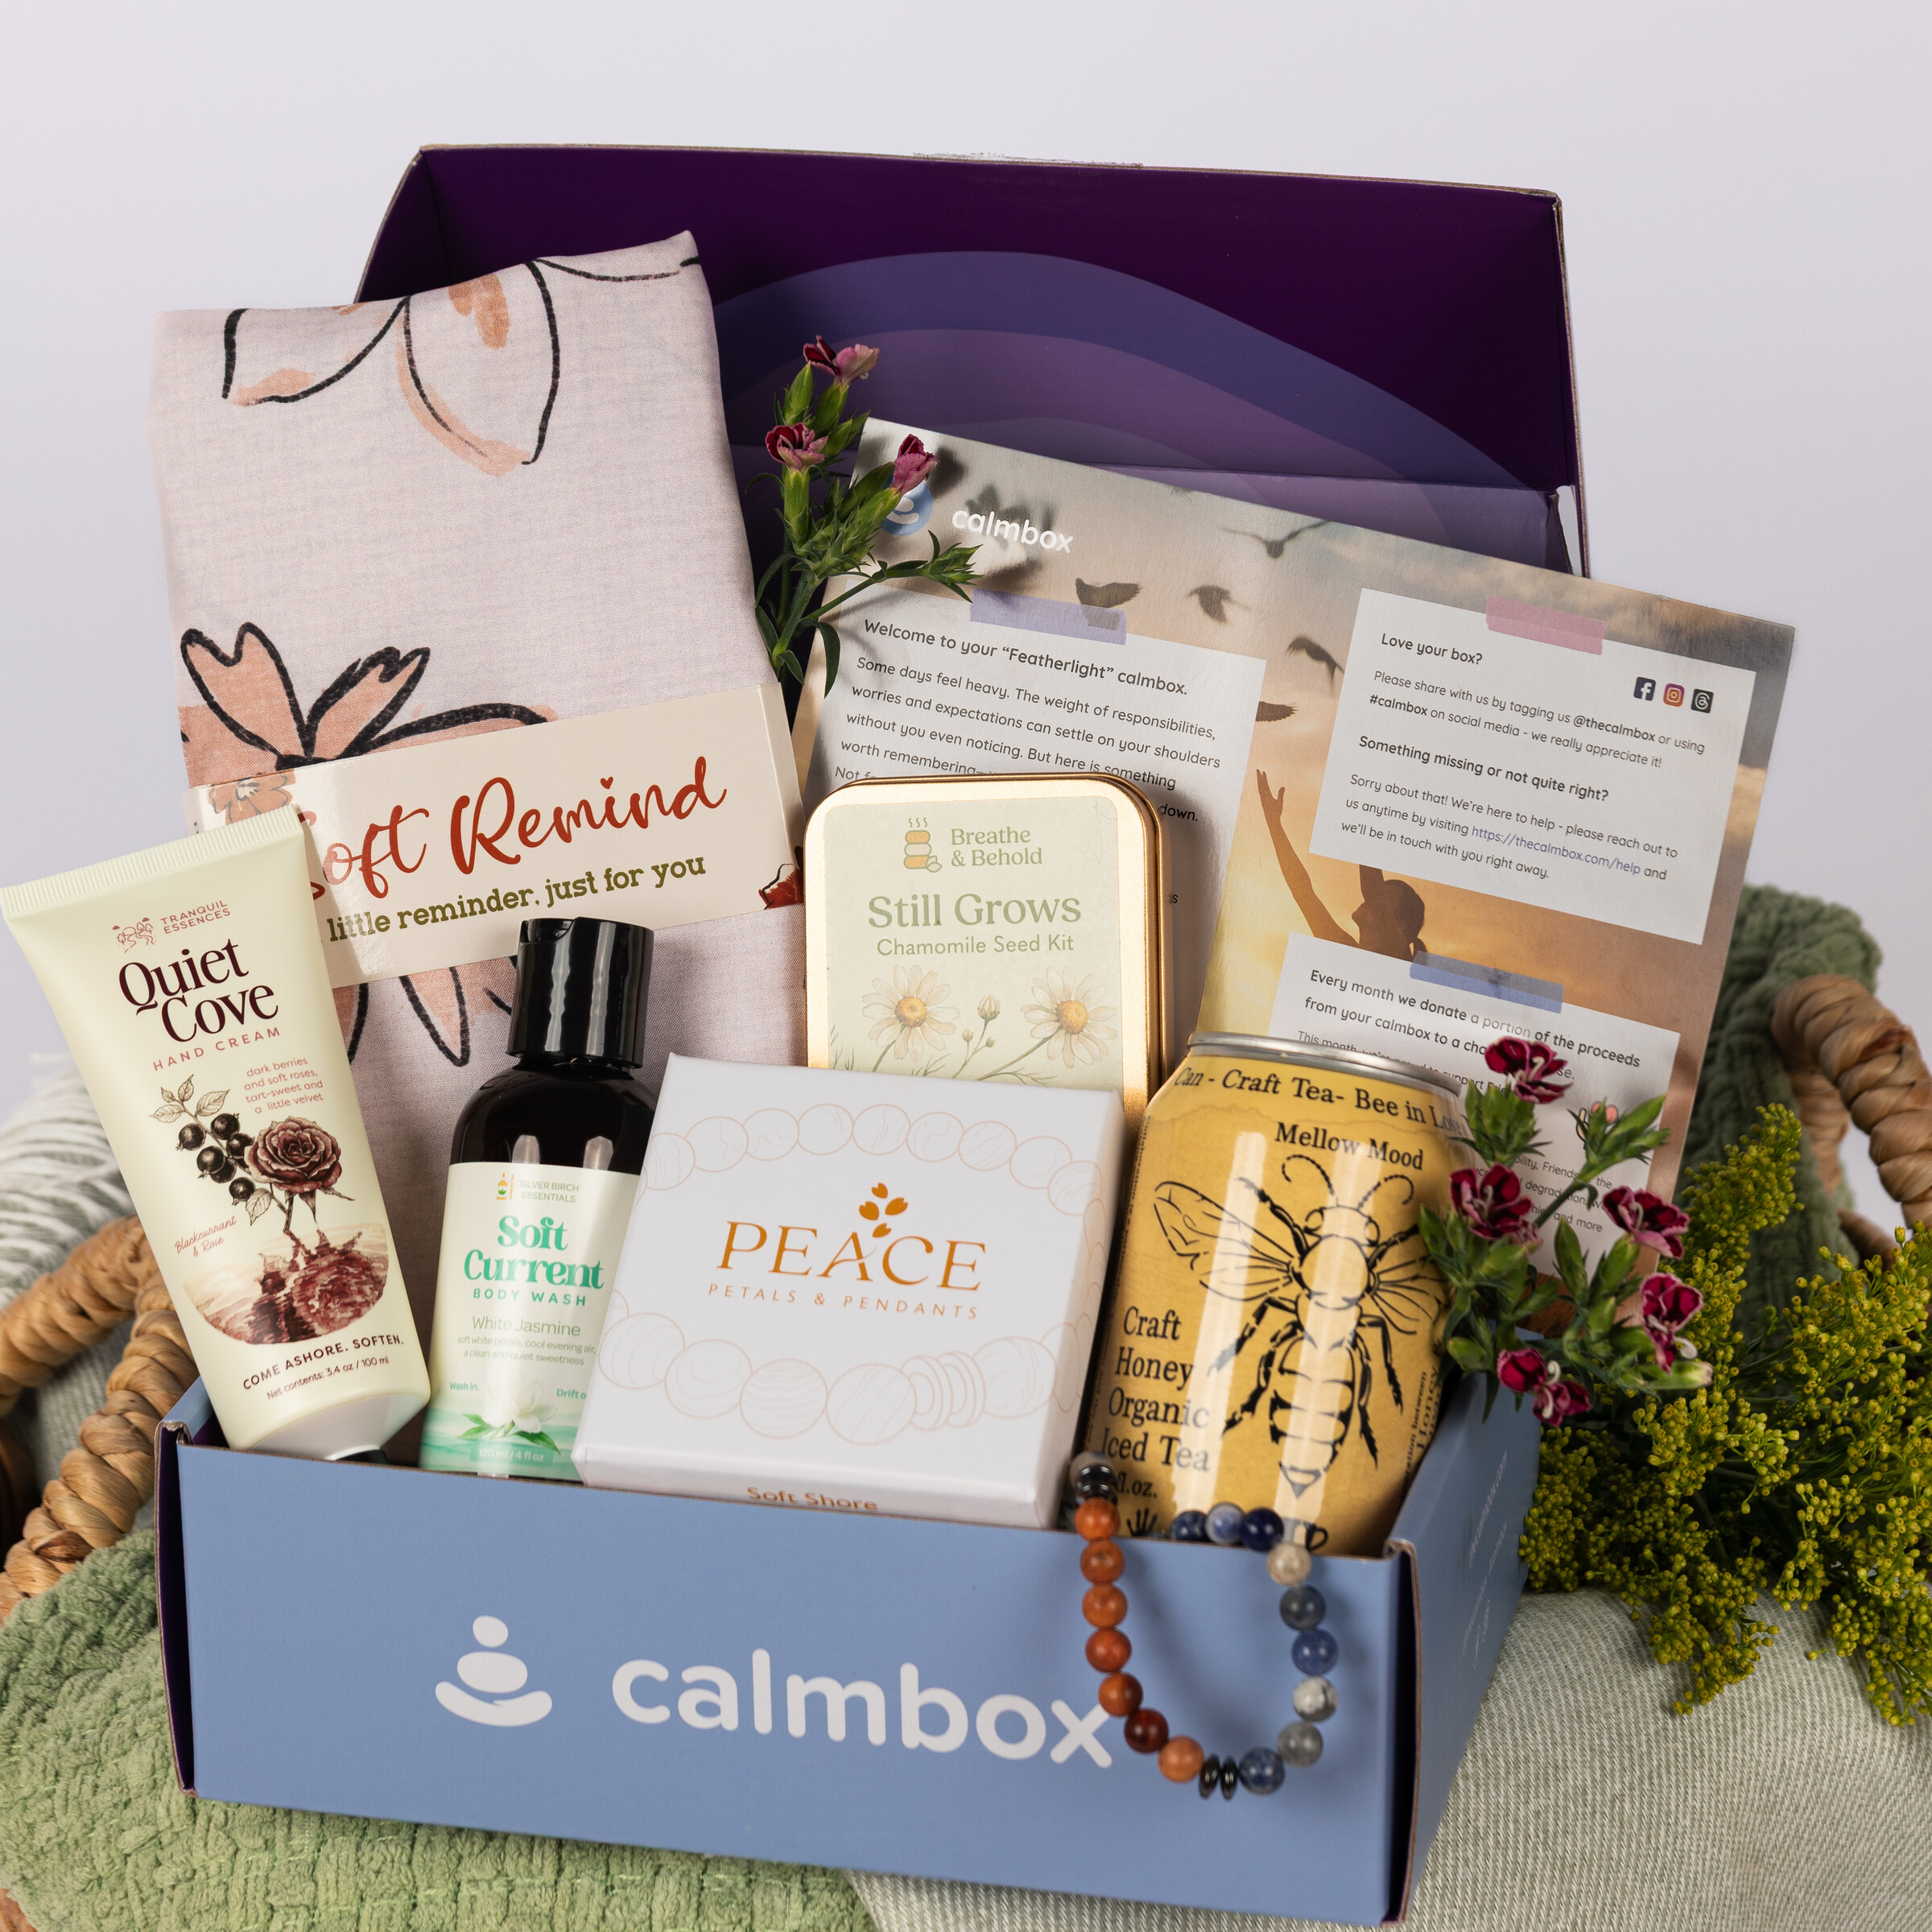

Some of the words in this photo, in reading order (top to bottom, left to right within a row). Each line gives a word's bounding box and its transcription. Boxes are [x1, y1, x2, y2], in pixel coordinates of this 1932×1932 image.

[952, 508, 1073, 553] calmbox
[865, 619, 935, 645] Welcome
[940, 635, 956, 649] to
[960, 641, 997, 656] your
[1117, 672, 1187, 695] calmbox.
[1381, 633, 1413, 650] Love
[1416, 642, 1447, 657] your
[1451, 647, 1482, 664] box?
[857, 656, 895, 675] Some
[899, 665, 931, 683] days
[936, 672, 962, 687] feel
[965, 678, 1009, 699] heavy.
[1015, 687, 1039, 703] The
[1044, 696, 1089, 713] weight
[1093, 705, 1109, 716] of
[1112, 710, 1215, 740] responsibilities,
[1374, 671, 1411, 687] Please
[1414, 679, 1446, 696] share
[1450, 688, 1472, 701] with
[1476, 695, 1488, 704] us
[1492, 696, 1506, 711] by
[1509, 700, 1554, 721] tagging
[1557, 713, 1571, 723] us
[1573, 715, 1655, 741] @thecalmbox
[1657, 735, 1671, 744] or
[1674, 739, 1704, 754] using
[852, 683, 901, 704] worries
[905, 697, 931, 710] and
[935, 703, 1022, 728] expectations
[1026, 721, 1051, 734] can
[1055, 727, 1093, 742] settle
[1097, 736, 1114, 746] on
[1118, 740, 1150, 753] your
[1154, 745, 1220, 767] shoulders
[1369, 694, 1427, 716] #calmbox
[1430, 709, 1444, 719] on
[1447, 713, 1481, 727] social
[1484, 721, 1519, 736] media
[1531, 731, 1547, 742] we
[1550, 736, 1582, 752] really
[1585, 744, 1648, 764] appreciate
[1650, 756, 1662, 767] it!
[1359, 735, 1430, 764] Something
[1434, 754, 1483, 775] missing
[1487, 766, 1502, 777] or
[1505, 770, 1528, 783] not
[1531, 776, 1565, 791] quite
[1568, 783, 1608, 801] right?
[450, 755, 727, 873] Remind
[1350, 774, 1381, 792] Sorry
[1385, 782, 1418, 799] about
[1422, 791, 1447, 805] that!
[1486, 804, 1512, 819] here
[1515, 811, 1527, 823] to
[1530, 814, 1554, 831] help
[1565, 824, 1604, 840] please
[1607, 835, 1639, 848] reach
[1642, 843, 1662, 854] out
[1666, 846, 1677, 857] to
[950, 826, 1031, 845] Breathe
[1346, 799, 1359, 809] us
[1361, 803, 1408, 819] anytime
[1411, 811, 1426, 826] by
[1429, 817, 1468, 836] visiting
[1472, 825, 1641, 875] https://thecalmbox.com/help
[1644, 868, 1667, 880] and
[952, 850, 965, 867] &
[972, 848, 1043, 866] Behold
[160, 900, 228, 924] TRANQUIL
[326, 911, 390, 943] little
[396, 888, 539, 929] reminder,
[544, 871, 597, 908] just
[603, 867, 644, 891] for
[650, 857, 706, 888] you
[868, 894, 942, 929] Still
[955, 893, 1082, 927] Grows
[163, 908, 230, 934] ESSENCES
[877, 935, 987, 956] Chamomile
[993, 934, 1040, 953] Seed
[1048, 933, 1075, 952] Kit
[118, 938, 250, 1016] Quiet
[161, 985, 279, 1044] Cove
[1305, 997, 1337, 1015] from
[1340, 1009, 1372, 1023] your
[1375, 1018, 1430, 1040] calmbox
[1311, 969, 1348, 991] Every
[1351, 982, 1393, 1001] month
[1398, 994, 1416, 1007] we
[1420, 999, 1467, 1021] donate
[1534, 1030, 1550, 1042] of
[1553, 1034, 1575, 1050] the
[1578, 1042, 1641, 1068] proceeds
[152, 1047, 204, 1071] HAND
[215, 1027, 279, 1051] CREAM
[246, 1064, 271, 1076] dark
[272, 1057, 308, 1070] berries
[244, 1077, 265, 1090] and
[267, 1072, 287, 1084] soft
[289, 1069, 318, 1079] roses,
[245, 1084, 302, 1103] tart-sweet
[303, 1079, 323, 1089] and
[1221, 1068, 1282, 1094] Craft
[1355, 1088, 1398, 1117] Bee
[1405, 1100, 1426, 1124] in
[266, 1098, 291, 1110] little
[292, 1092, 323, 1104] velvet
[1274, 1121, 1360, 1154] Mellow
[1367, 1137, 1423, 1170] Mood
[520, 1180, 549, 1190] SILVER
[551, 1182, 579, 1191] BIRCH
[522, 1191, 576, 1203] ESSENTIALS
[174, 1216, 237, 1254] Blackcurrant
[192, 1246, 198, 1257] &
[201, 1236, 225, 1253] Rose
[497, 1216, 568, 1251] Soft
[464, 1249, 605, 1290] Current
[716, 1220, 987, 1292] PEACE
[473, 1288, 518, 1299] BODY
[530, 1290, 585, 1308] WASH
[708, 1283, 795, 1302] PETALS
[814, 1292, 824, 1305] &
[843, 1295, 976, 1319] PENDANTS
[473, 1315, 512, 1331] White
[515, 1318, 581, 1336] Jasmine
[1123, 1306, 1181, 1340] Craft
[243, 1364, 281, 1389] COME
[285, 1343, 349, 1370] ASHORE.
[353, 1334, 404, 1349] SOFTEN.
[510, 1352, 534, 1361] quiet
[535, 1354, 584, 1365] sweetness
[525, 1340, 545, 1349] cool
[547, 1342, 582, 1354] evening
[584, 1345, 596, 1354] air,
[266, 1389, 283, 1400] Net
[284, 1371, 324, 1392] contents:
[325, 1365, 341, 1377] 3.4
[343, 1363, 353, 1373] oz
[361, 1356, 378, 1368] 100
[379, 1356, 389, 1365] ml
[1114, 1346, 1195, 1390] Honey
[1108, 1386, 1209, 1427] Organic
[1102, 1427, 1149, 1462] Iced
[1159, 1435, 1209, 1472] Tea
[747, 1487, 798, 1505] Soft
[805, 1492, 878, 1511] Shore
[612, 1649, 1113, 1769] calmbox
